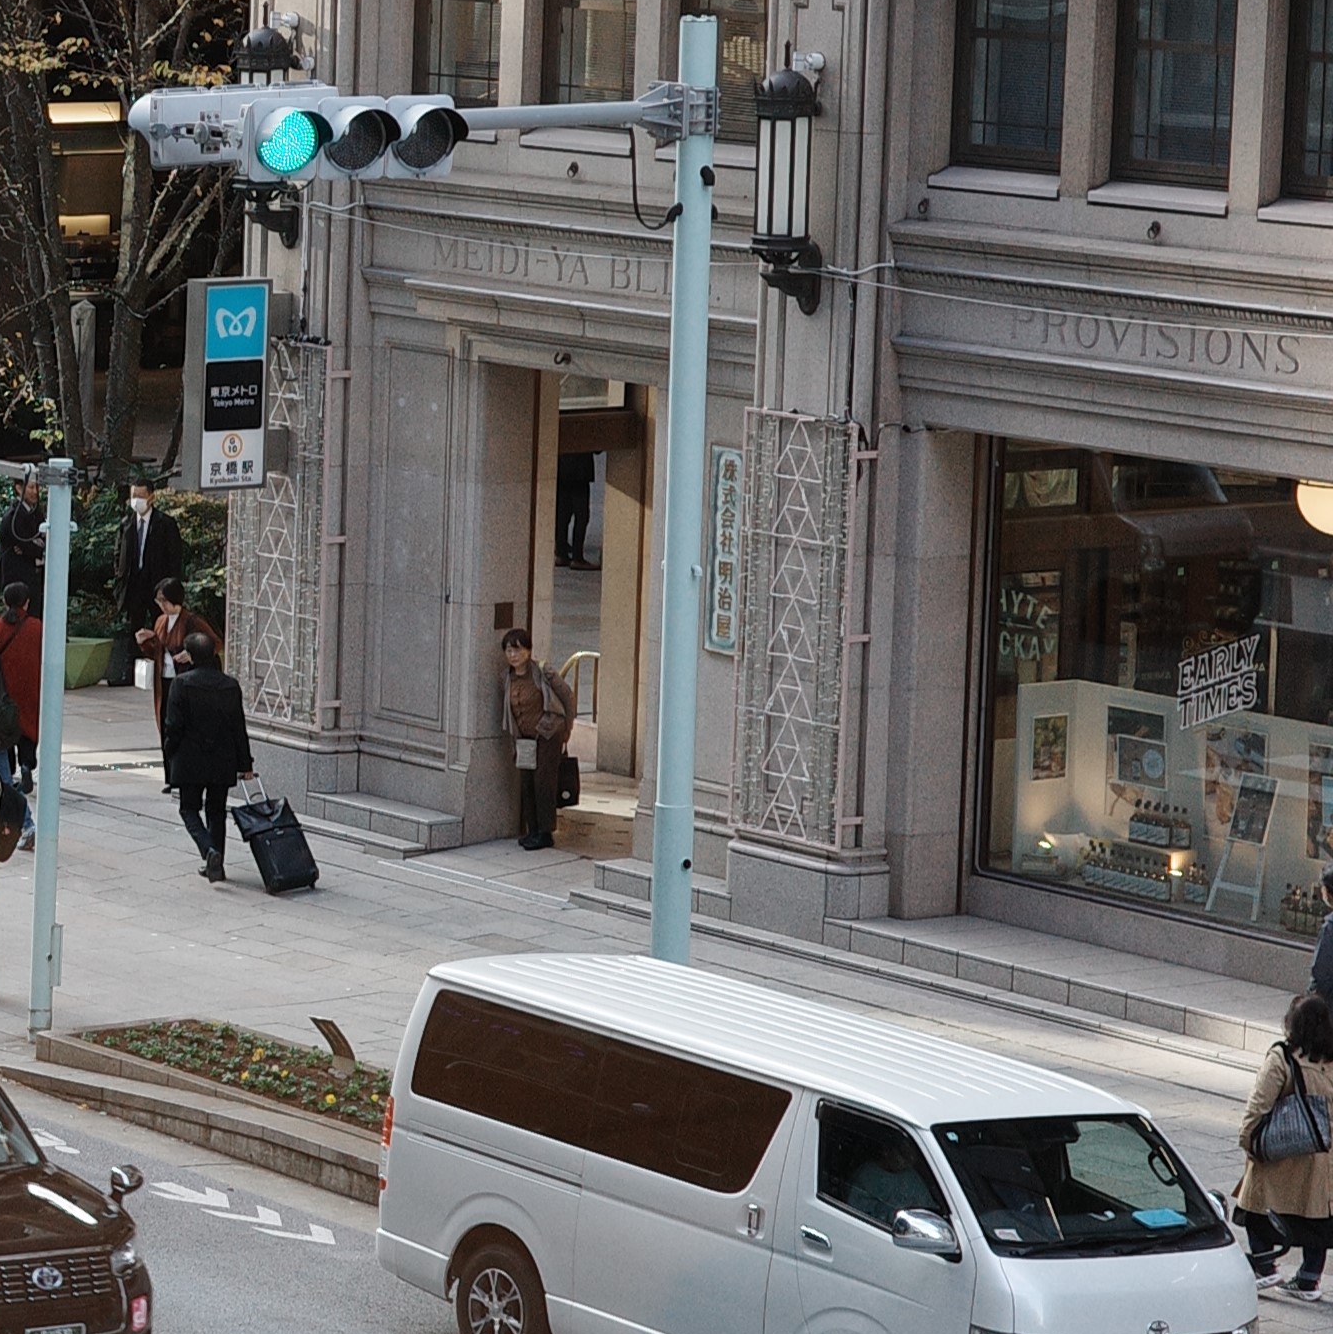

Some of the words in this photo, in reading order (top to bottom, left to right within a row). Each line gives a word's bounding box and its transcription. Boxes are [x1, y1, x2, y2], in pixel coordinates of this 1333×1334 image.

[433, 235, 590, 285] MEIDI-YA
[1009, 308, 1301, 375] PROVISIONS
[210, 385, 258, 398] 東京メトロ
[213, 398, 233, 408] Tokyo
[234, 397, 255, 407] Metro
[228, 445, 238, 453] 10
[209, 474, 240, 485] Kyobashi
[210, 460, 254, 476] 京橋駅
[716, 458, 738, 640] 株式会社明治屋
[1177, 634, 1260, 695] EARLY
[1177, 671, 1258, 730] TIMES
